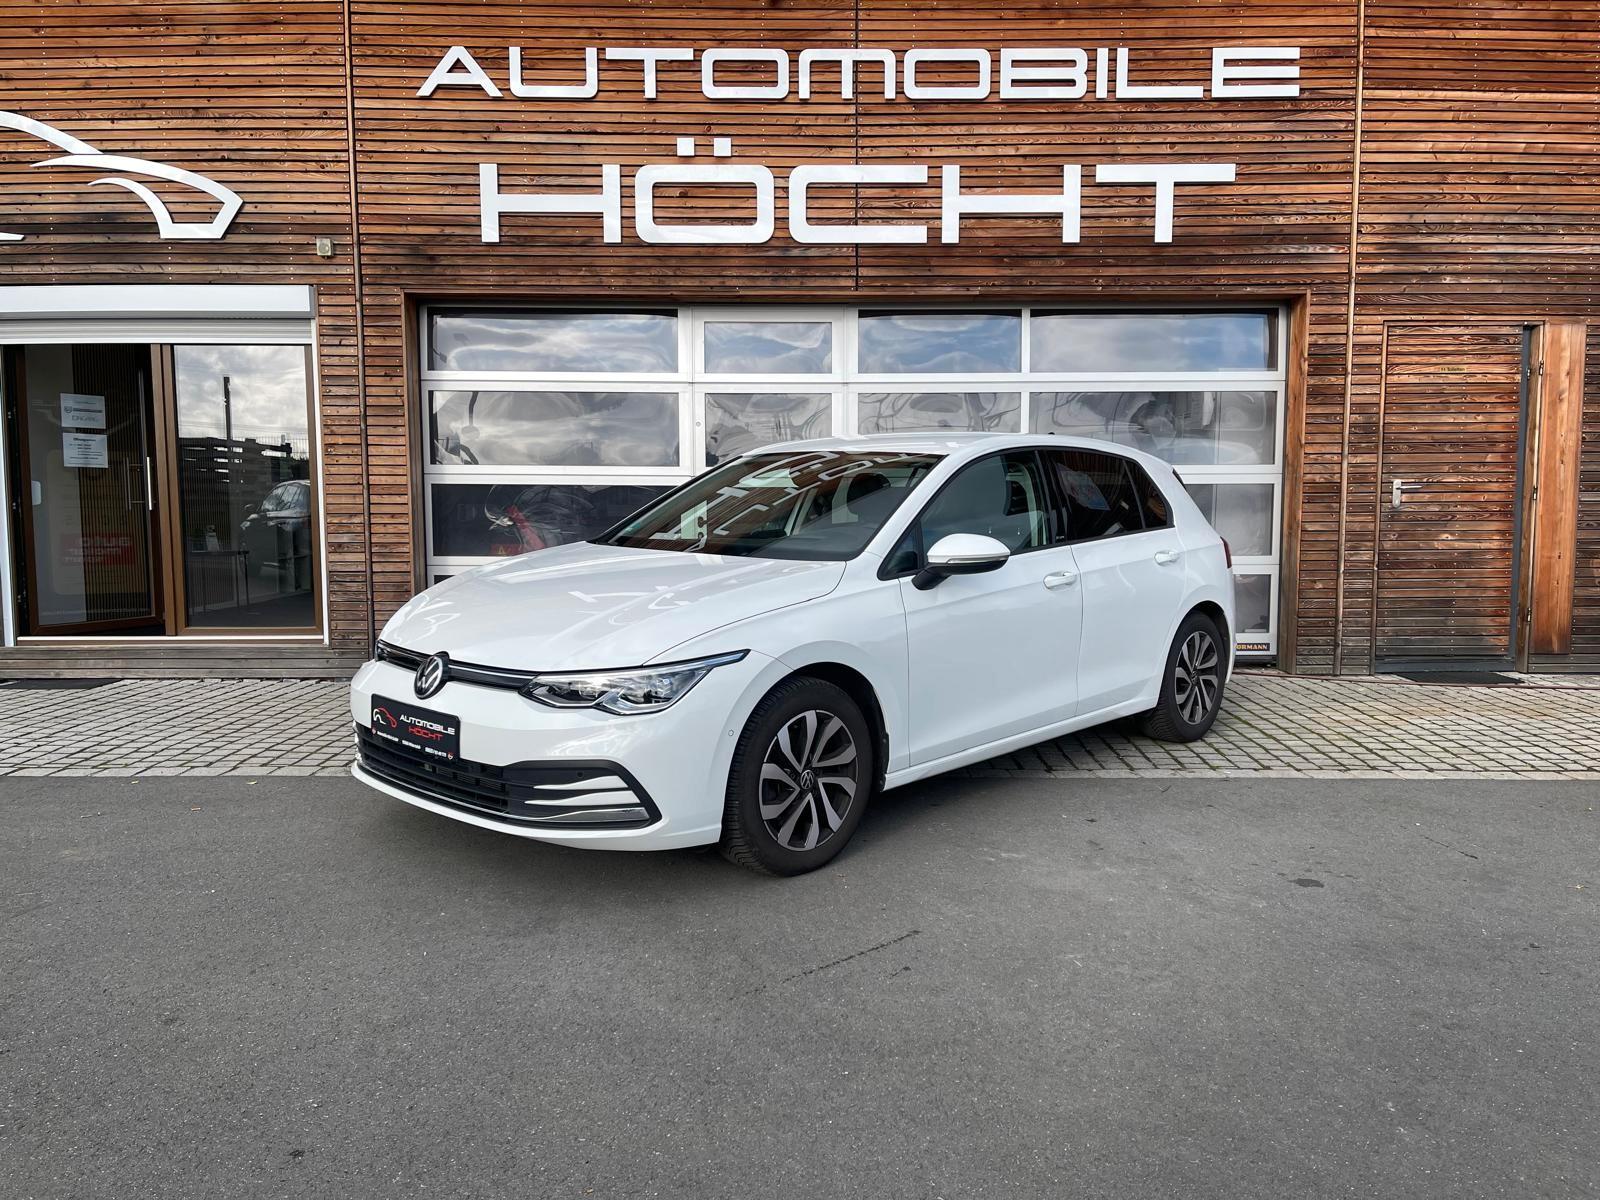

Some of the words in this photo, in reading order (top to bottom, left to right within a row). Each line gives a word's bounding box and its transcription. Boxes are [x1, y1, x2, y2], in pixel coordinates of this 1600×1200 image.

[416, 46, 1300, 99] AUTOMOBILE
[479, 137, 1236, 243] HÖCHT
[400, 714, 455, 735] AUTOMOBILE
